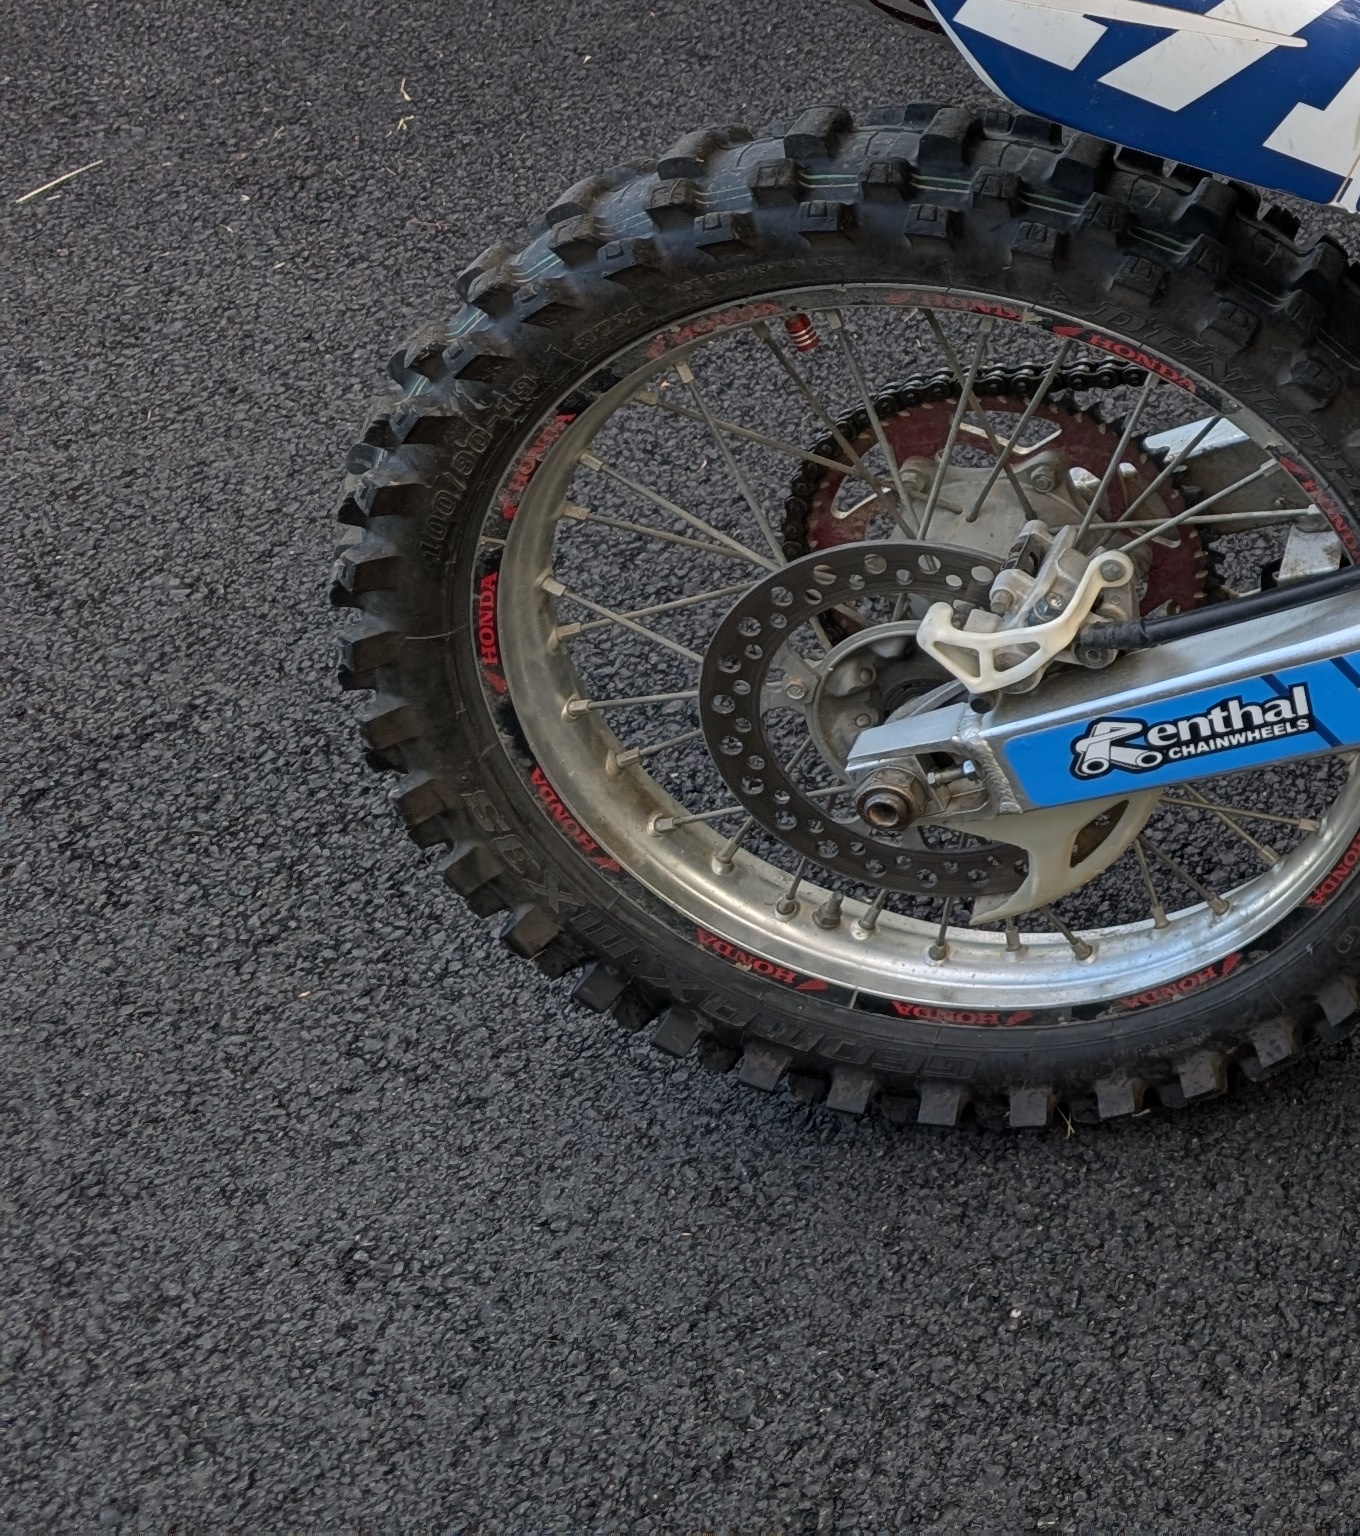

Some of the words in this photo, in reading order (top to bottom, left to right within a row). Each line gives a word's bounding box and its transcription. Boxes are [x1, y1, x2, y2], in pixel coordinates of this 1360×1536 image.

[1088, 329, 1199, 396] HONDA
[475, 568, 502, 662] HONDA
[1076, 685, 1309, 776] Renthal
[1168, 718, 1309, 760] CHAINWHEELS
[523, 766, 599, 852] HONDA
[690, 926, 798, 986] HONDA
[1119, 964, 1220, 1010] HONDA
[890, 1001, 1000, 1023] HONDA
